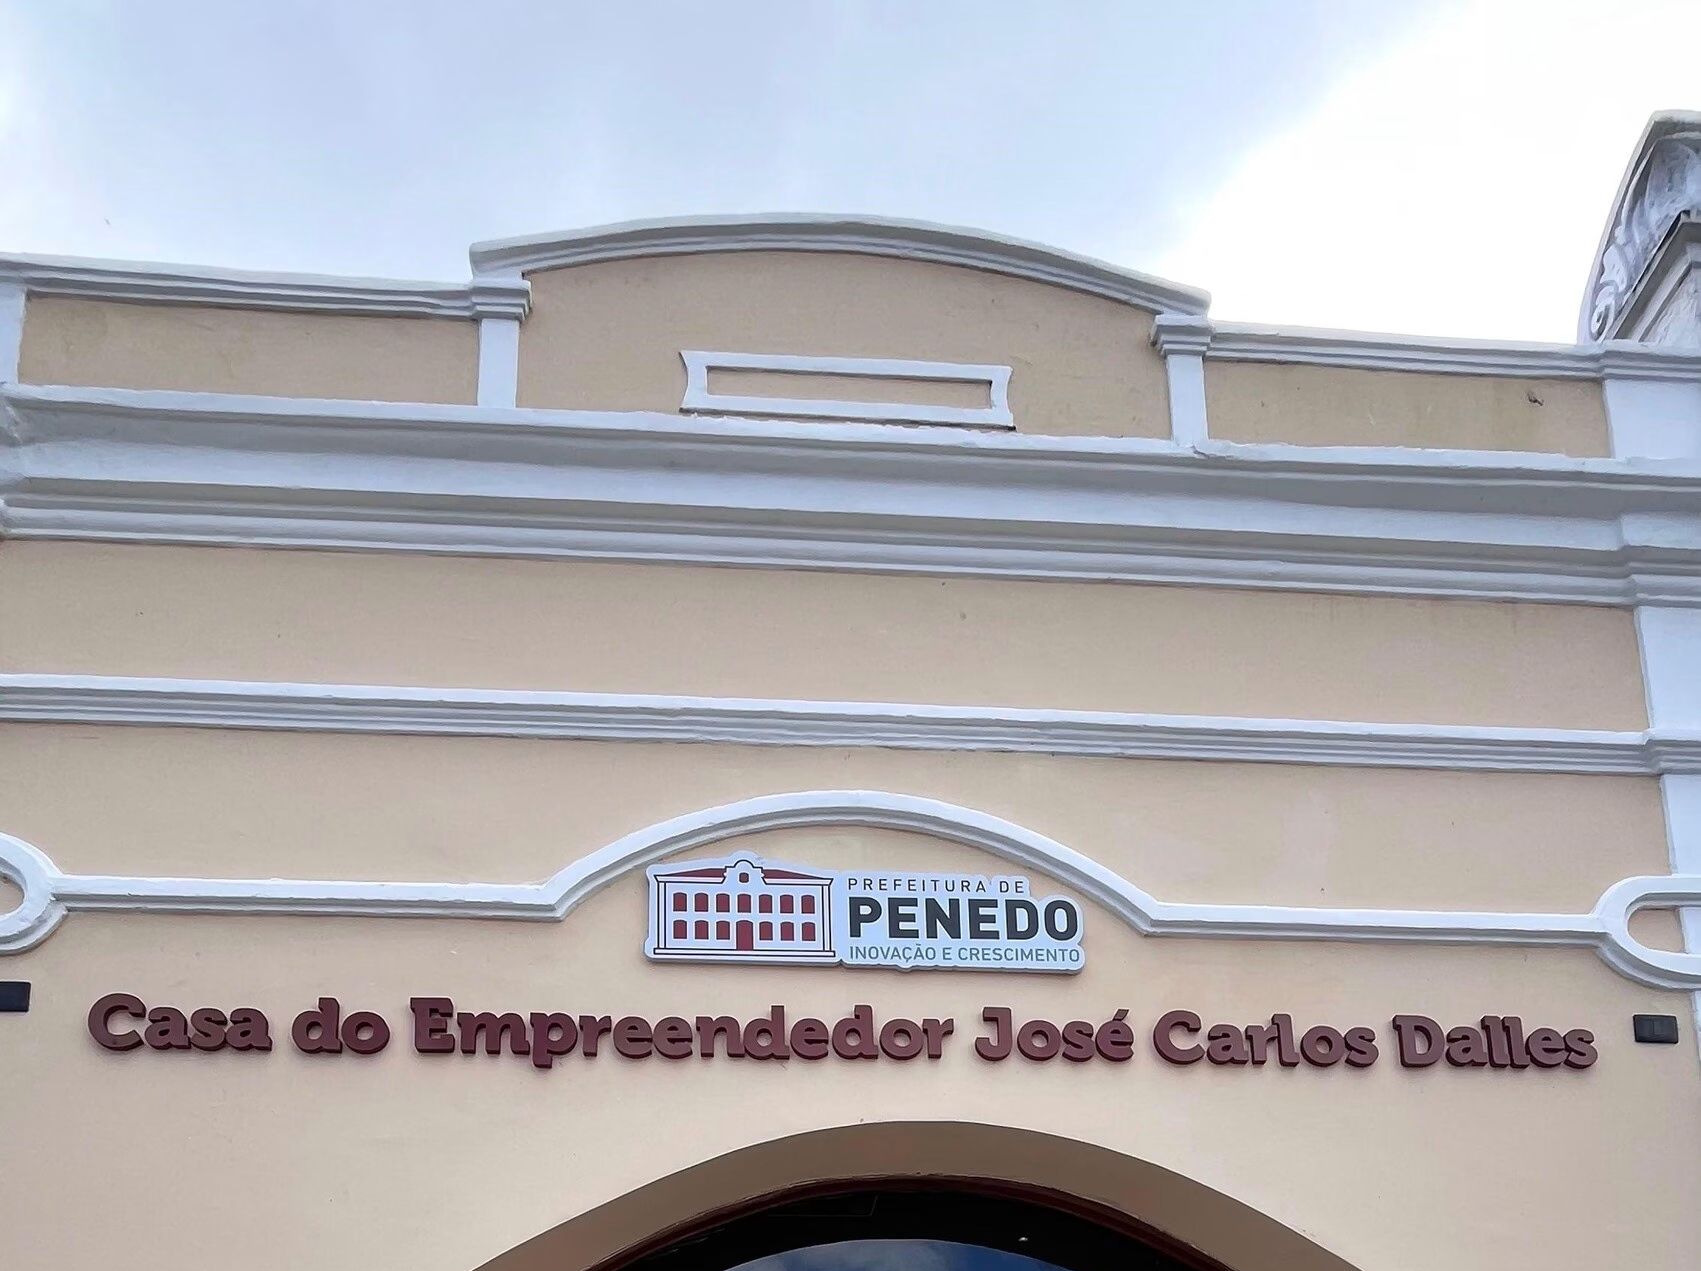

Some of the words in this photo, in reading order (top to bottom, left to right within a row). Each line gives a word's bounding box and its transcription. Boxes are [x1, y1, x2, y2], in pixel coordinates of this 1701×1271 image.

[848, 877, 987, 892] PREFEITURA
[999, 881, 1024, 894] DE
[848, 897, 1078, 942] PENEDO
[849, 943, 937, 961] INOVAÇÃO
[943, 948, 953, 961] E
[957, 947, 1080, 963] CRESCIMENTO
[88, 993, 272, 1052] Casa
[292, 997, 390, 1054] do
[411, 997, 954, 1068] Empreendedor
[975, 1006, 1135, 1062] José
[1153, 1010, 1379, 1068] Carlos
[1393, 1014, 1598, 1070] Dalles
